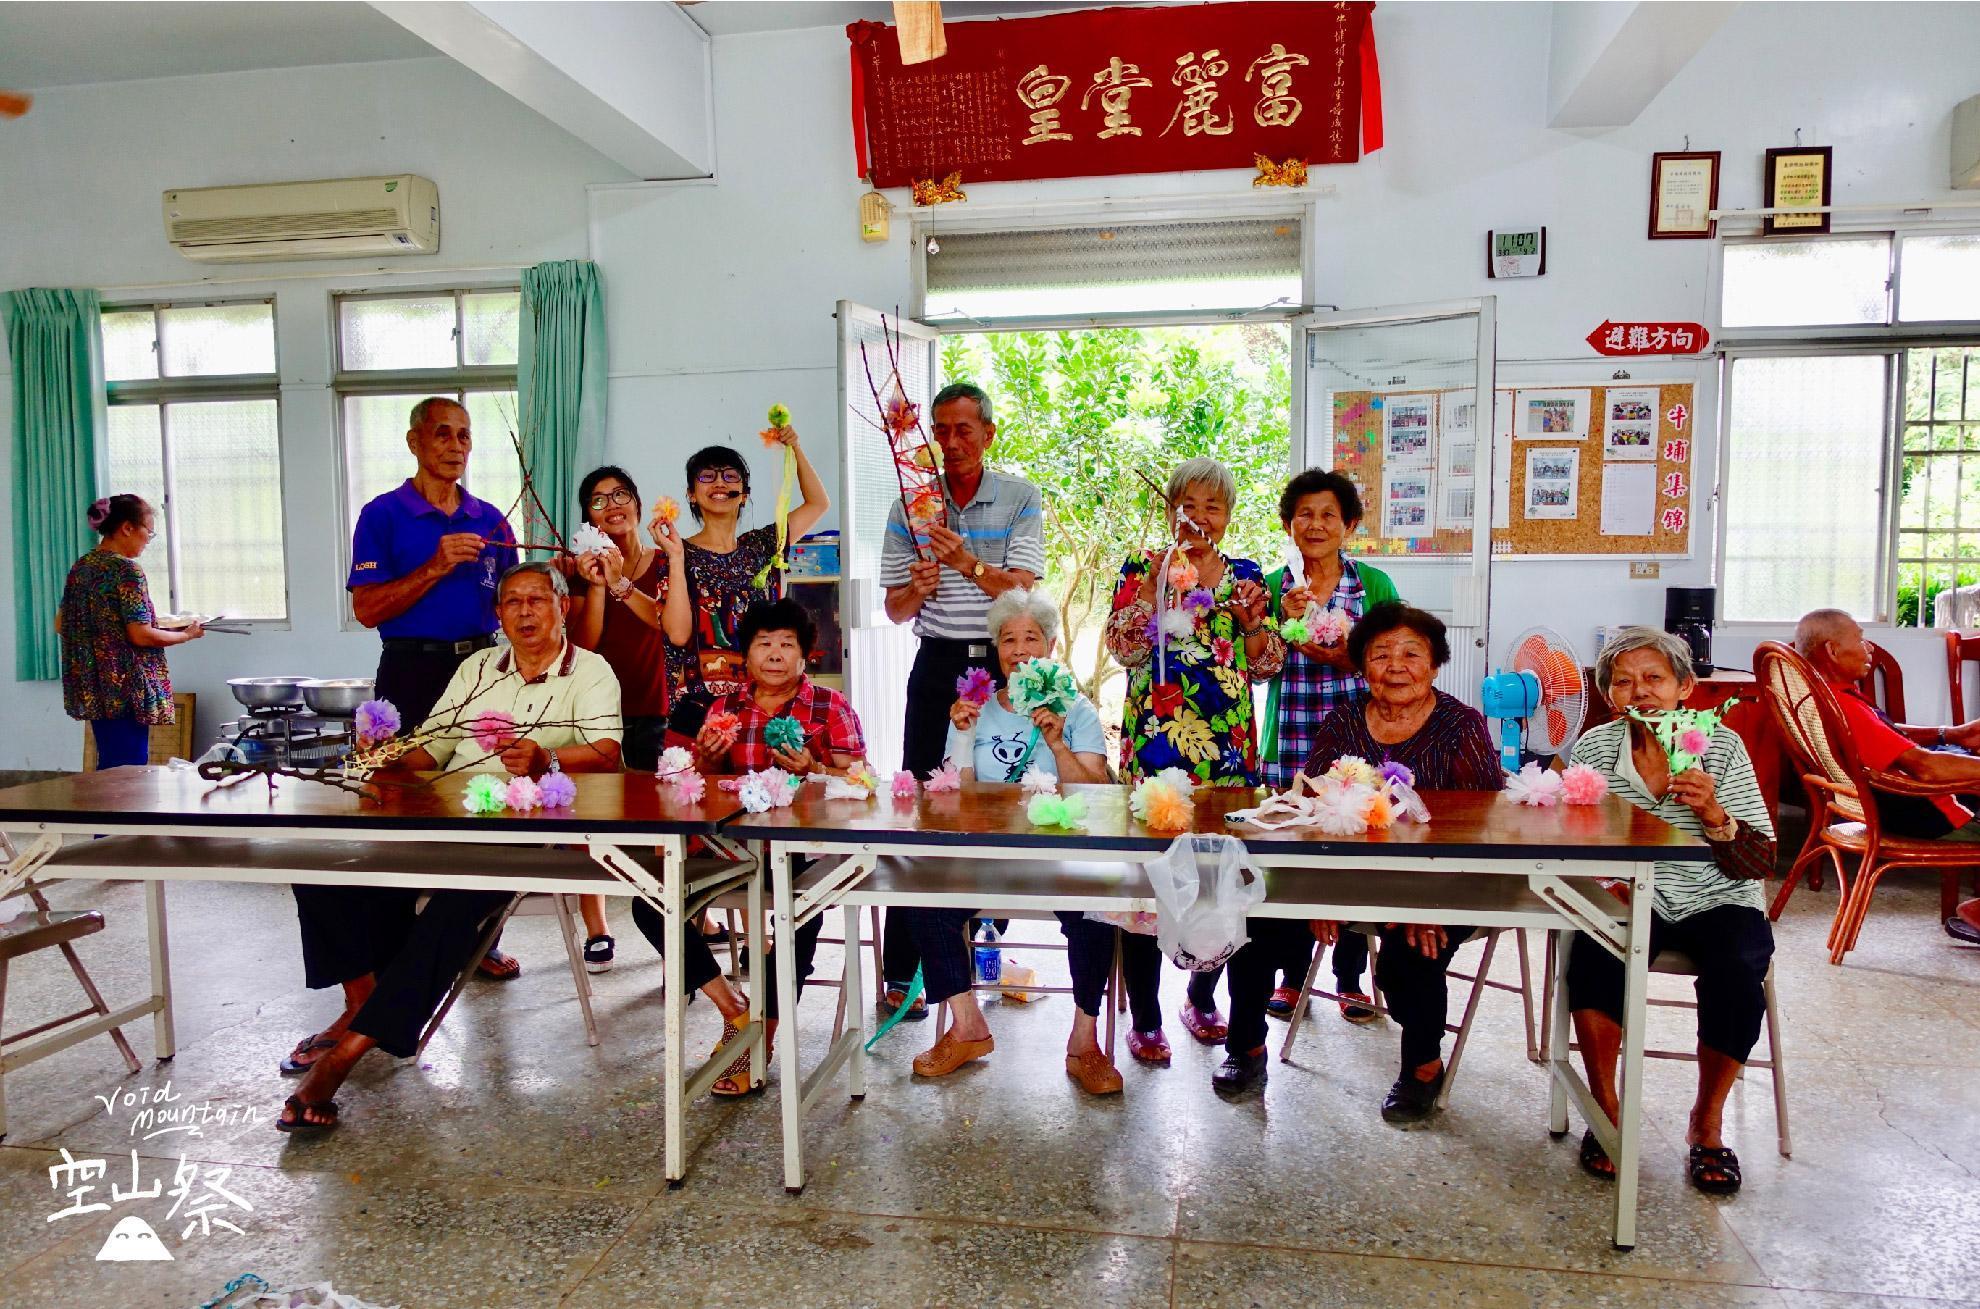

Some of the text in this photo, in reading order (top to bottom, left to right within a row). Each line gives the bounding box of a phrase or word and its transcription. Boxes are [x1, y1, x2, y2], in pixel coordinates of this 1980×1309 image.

[1604, 325, 1694, 352] 避難方向
[1663, 404, 1688, 533] 牛埔集錦
